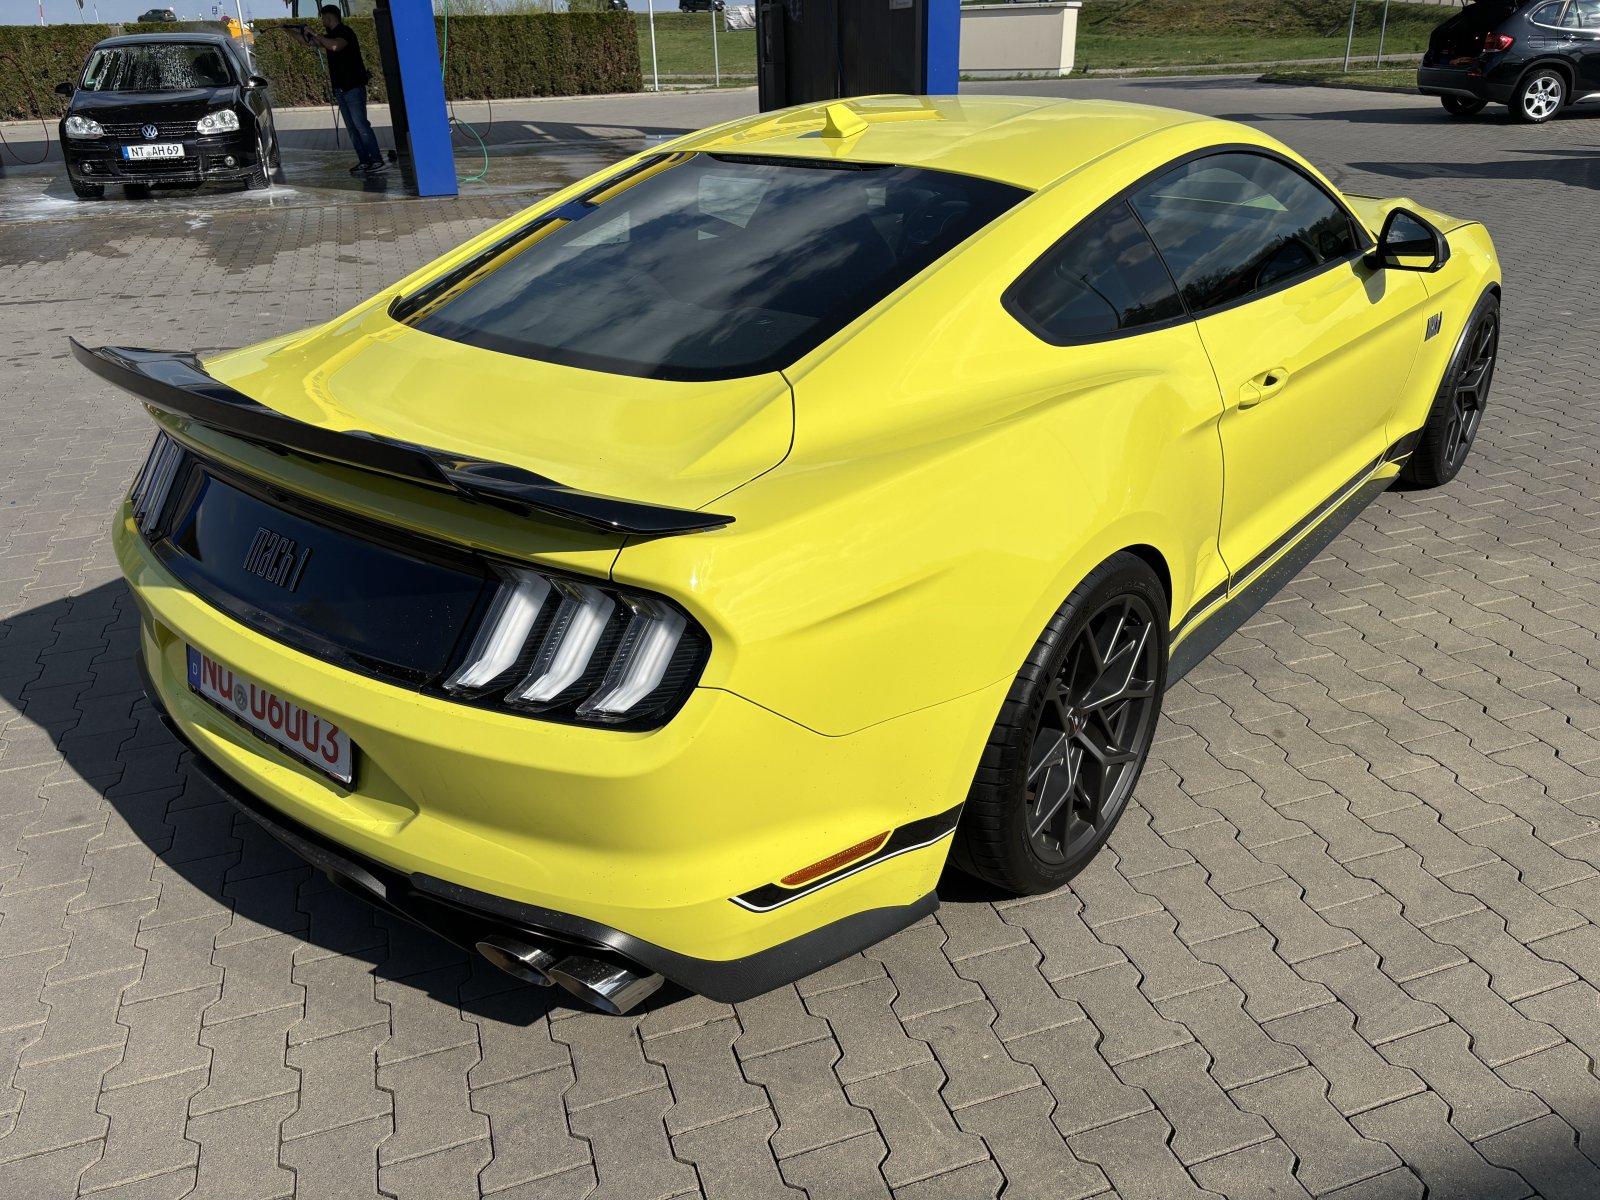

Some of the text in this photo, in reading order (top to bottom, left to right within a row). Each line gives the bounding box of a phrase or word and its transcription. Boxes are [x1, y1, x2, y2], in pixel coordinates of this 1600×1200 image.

[131, 145, 179, 157] NT AH 69
[192, 662, 198, 676] D
[202, 655, 233, 701] NU
